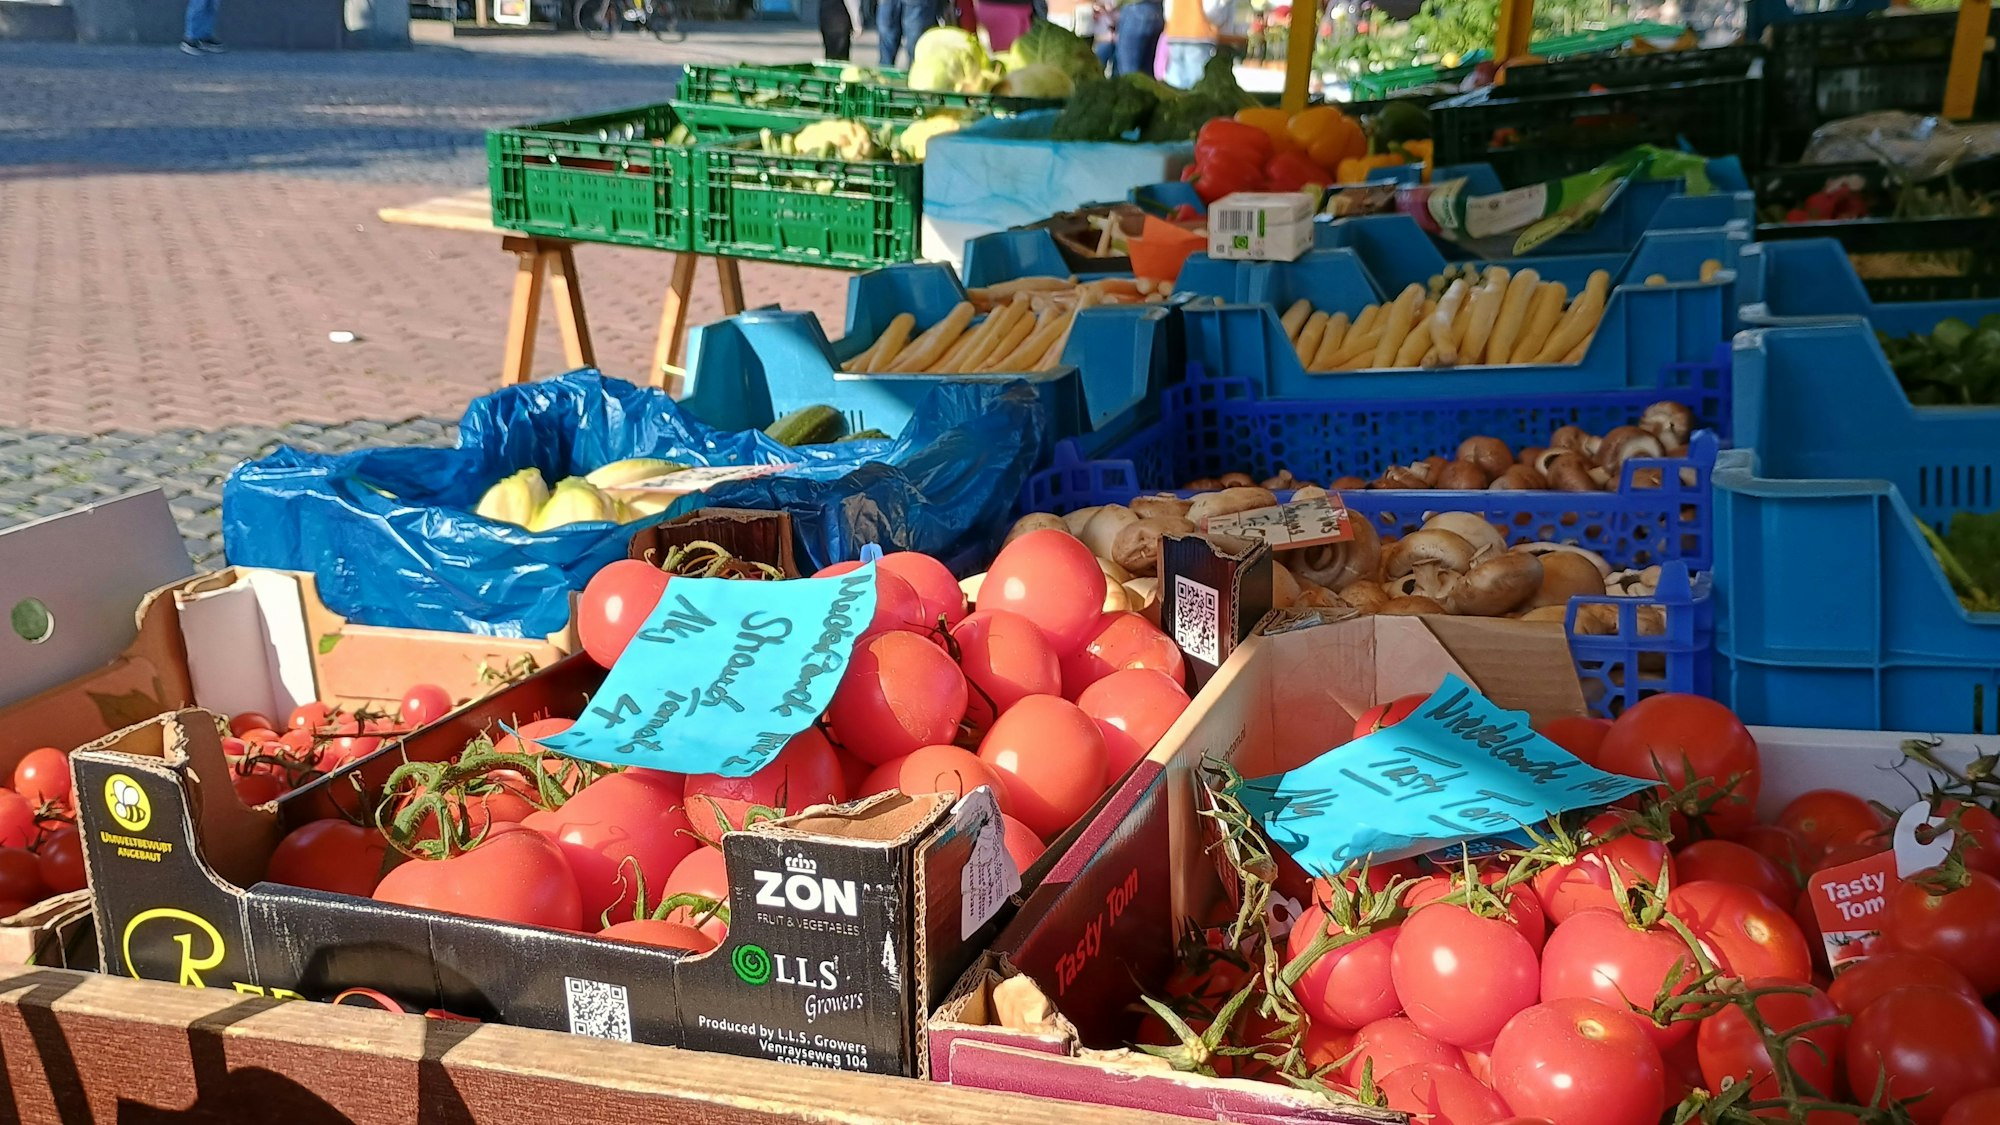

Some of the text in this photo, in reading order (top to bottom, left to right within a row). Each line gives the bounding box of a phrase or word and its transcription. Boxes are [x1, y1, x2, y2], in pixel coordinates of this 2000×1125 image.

[117, 847, 162, 863] ANGEBAUT
[753, 869, 858, 917] ZON
[1821, 871, 1885, 903] Tasty
[757, 912, 785, 928] FRUIT
[798, 918, 861, 937] VEGETABLES
[1835, 896, 1886, 922] Tom
[1055, 867, 1138, 996] Tasty Tom
[773, 953, 839, 991] LLS
[805, 992, 864, 1024] Growers
[699, 1015, 867, 1055] Produced by L.L.S. Growers
[759, 1039, 868, 1069] Venrayseweg 104
